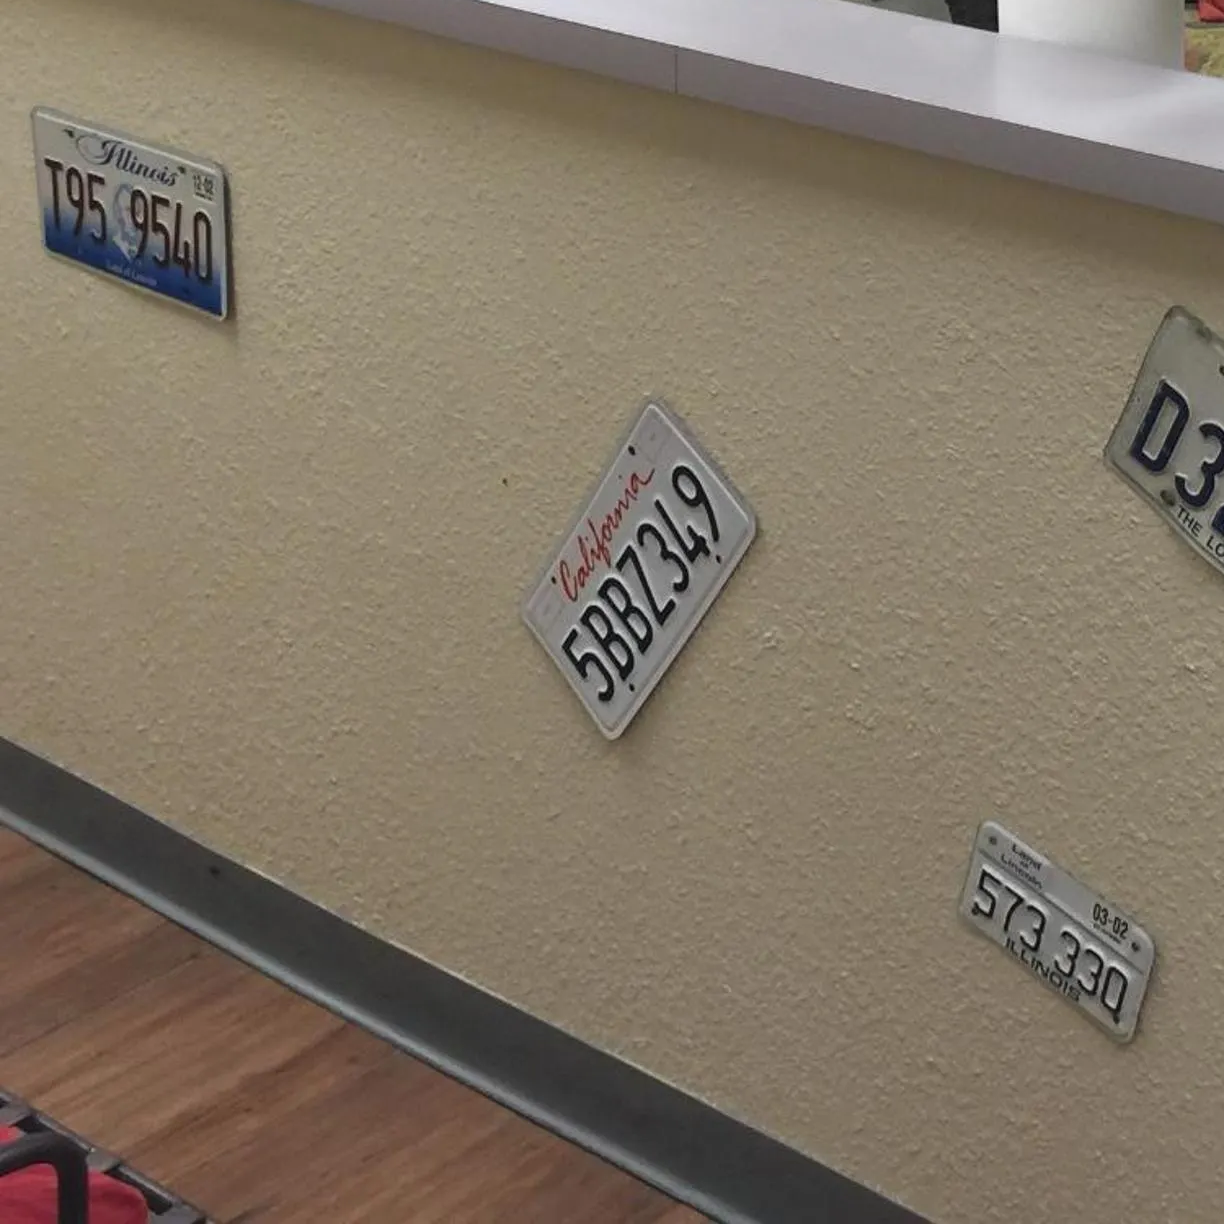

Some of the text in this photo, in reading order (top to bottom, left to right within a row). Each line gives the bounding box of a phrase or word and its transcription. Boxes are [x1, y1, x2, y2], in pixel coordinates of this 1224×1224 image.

[44, 158, 213, 282] T95 9540
[75, 134, 178, 187] Illinois
[557, 468, 655, 603] California
[561, 465, 720, 702] 5BBZ349
[1175, 507, 1203, 537] THE
[974, 869, 1129, 1012] 573 330
[1005, 937, 1082, 1002] ILLINOIS
